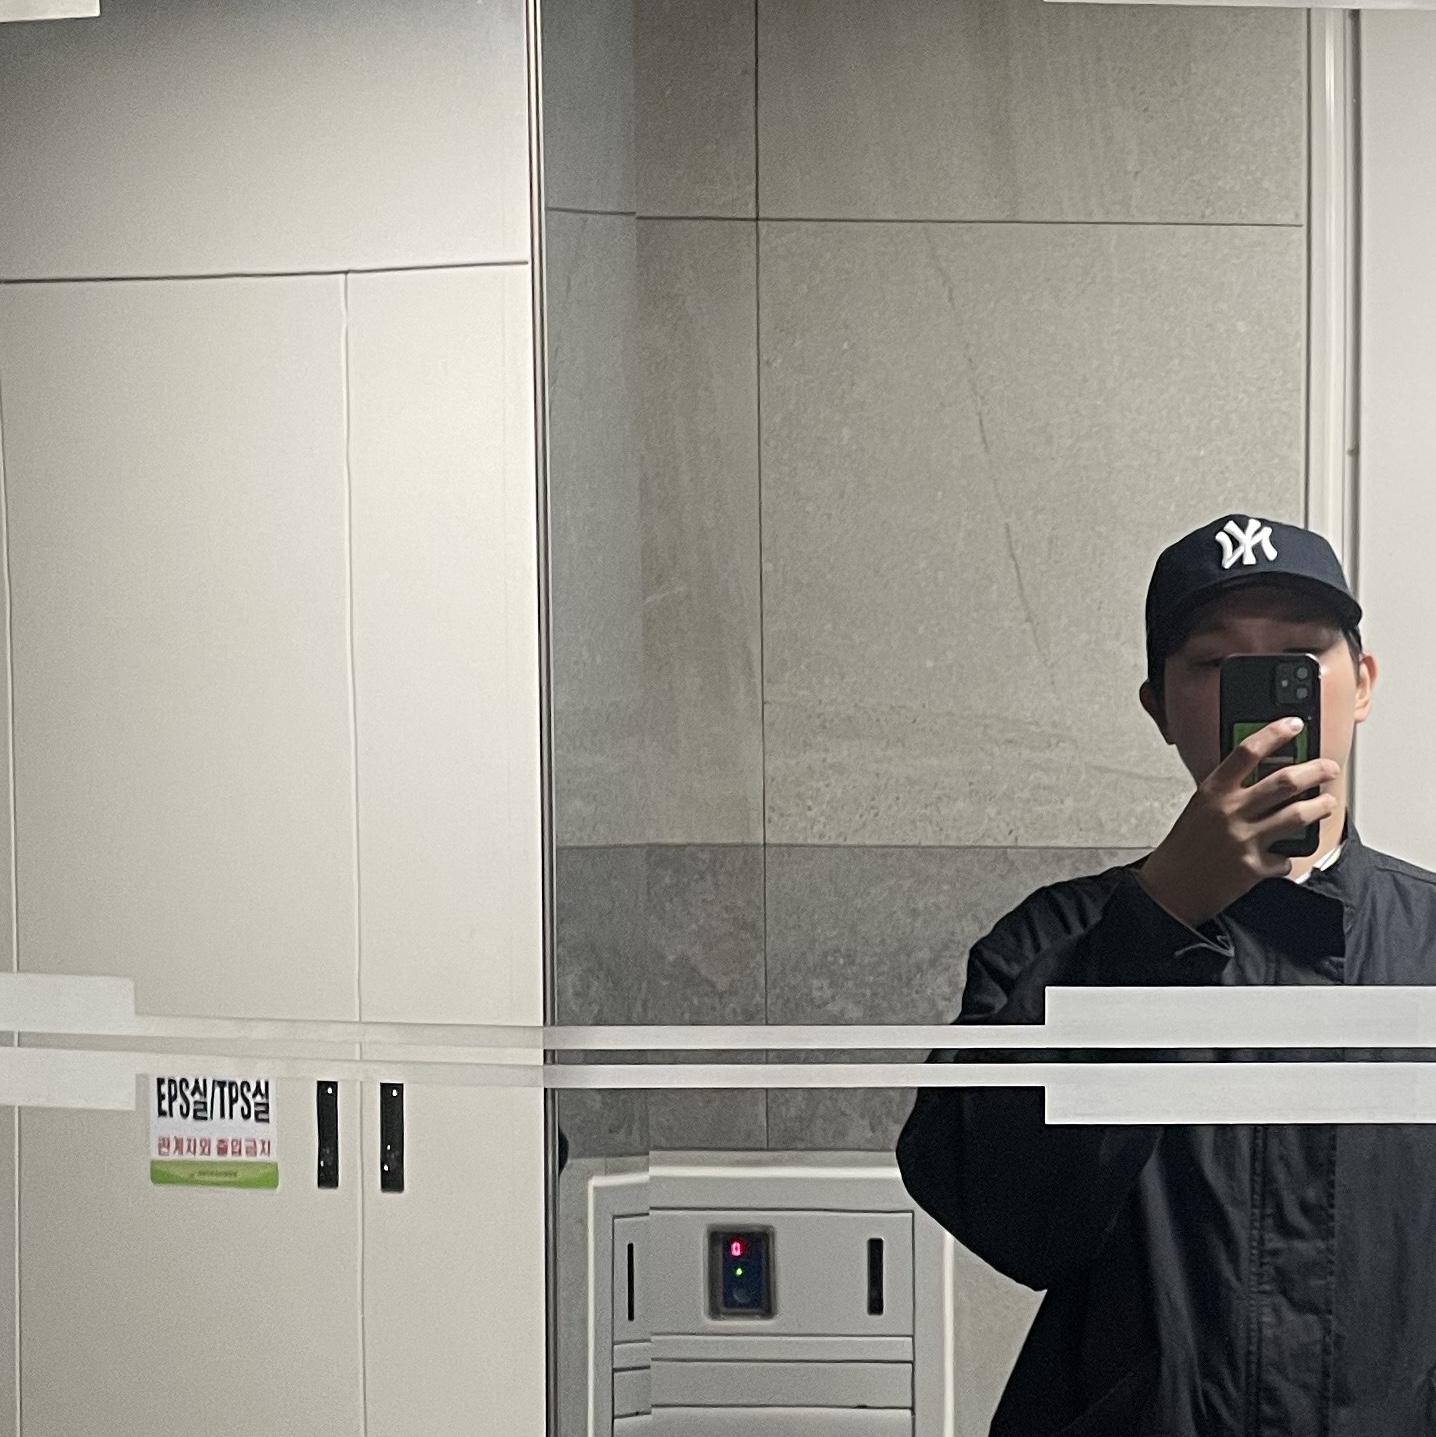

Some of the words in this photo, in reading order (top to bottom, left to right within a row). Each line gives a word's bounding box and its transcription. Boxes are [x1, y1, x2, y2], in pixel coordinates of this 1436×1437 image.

[156, 1077, 270, 1123] EPS실/TPS실
[158, 1136, 211, 1157] 관계자외
[216, 1137, 271, 1158] 출입금지
